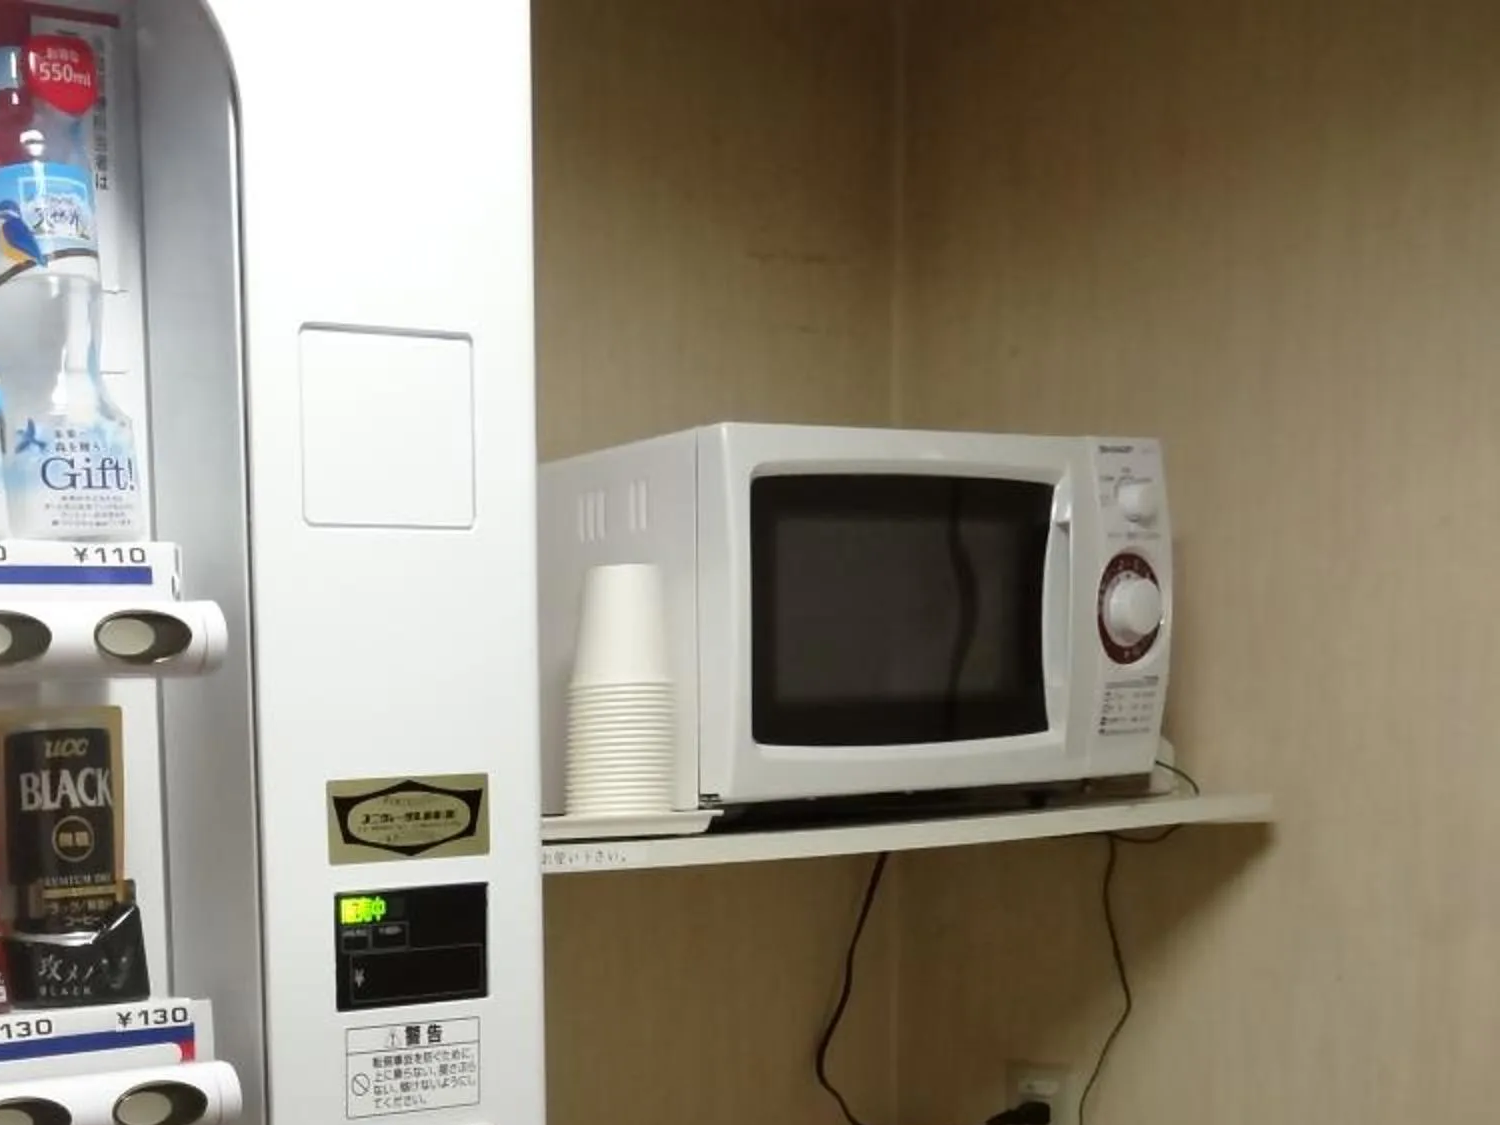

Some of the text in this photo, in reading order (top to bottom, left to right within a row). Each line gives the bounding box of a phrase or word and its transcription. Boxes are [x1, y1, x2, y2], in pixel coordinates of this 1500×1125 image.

[38, 63, 91, 88] 550ml
[41, 457, 136, 492] Gift!
[73, 546, 147, 564] ¥110
[19, 767, 113, 812] BLACK
[117, 1006, 188, 1027] ¥130
